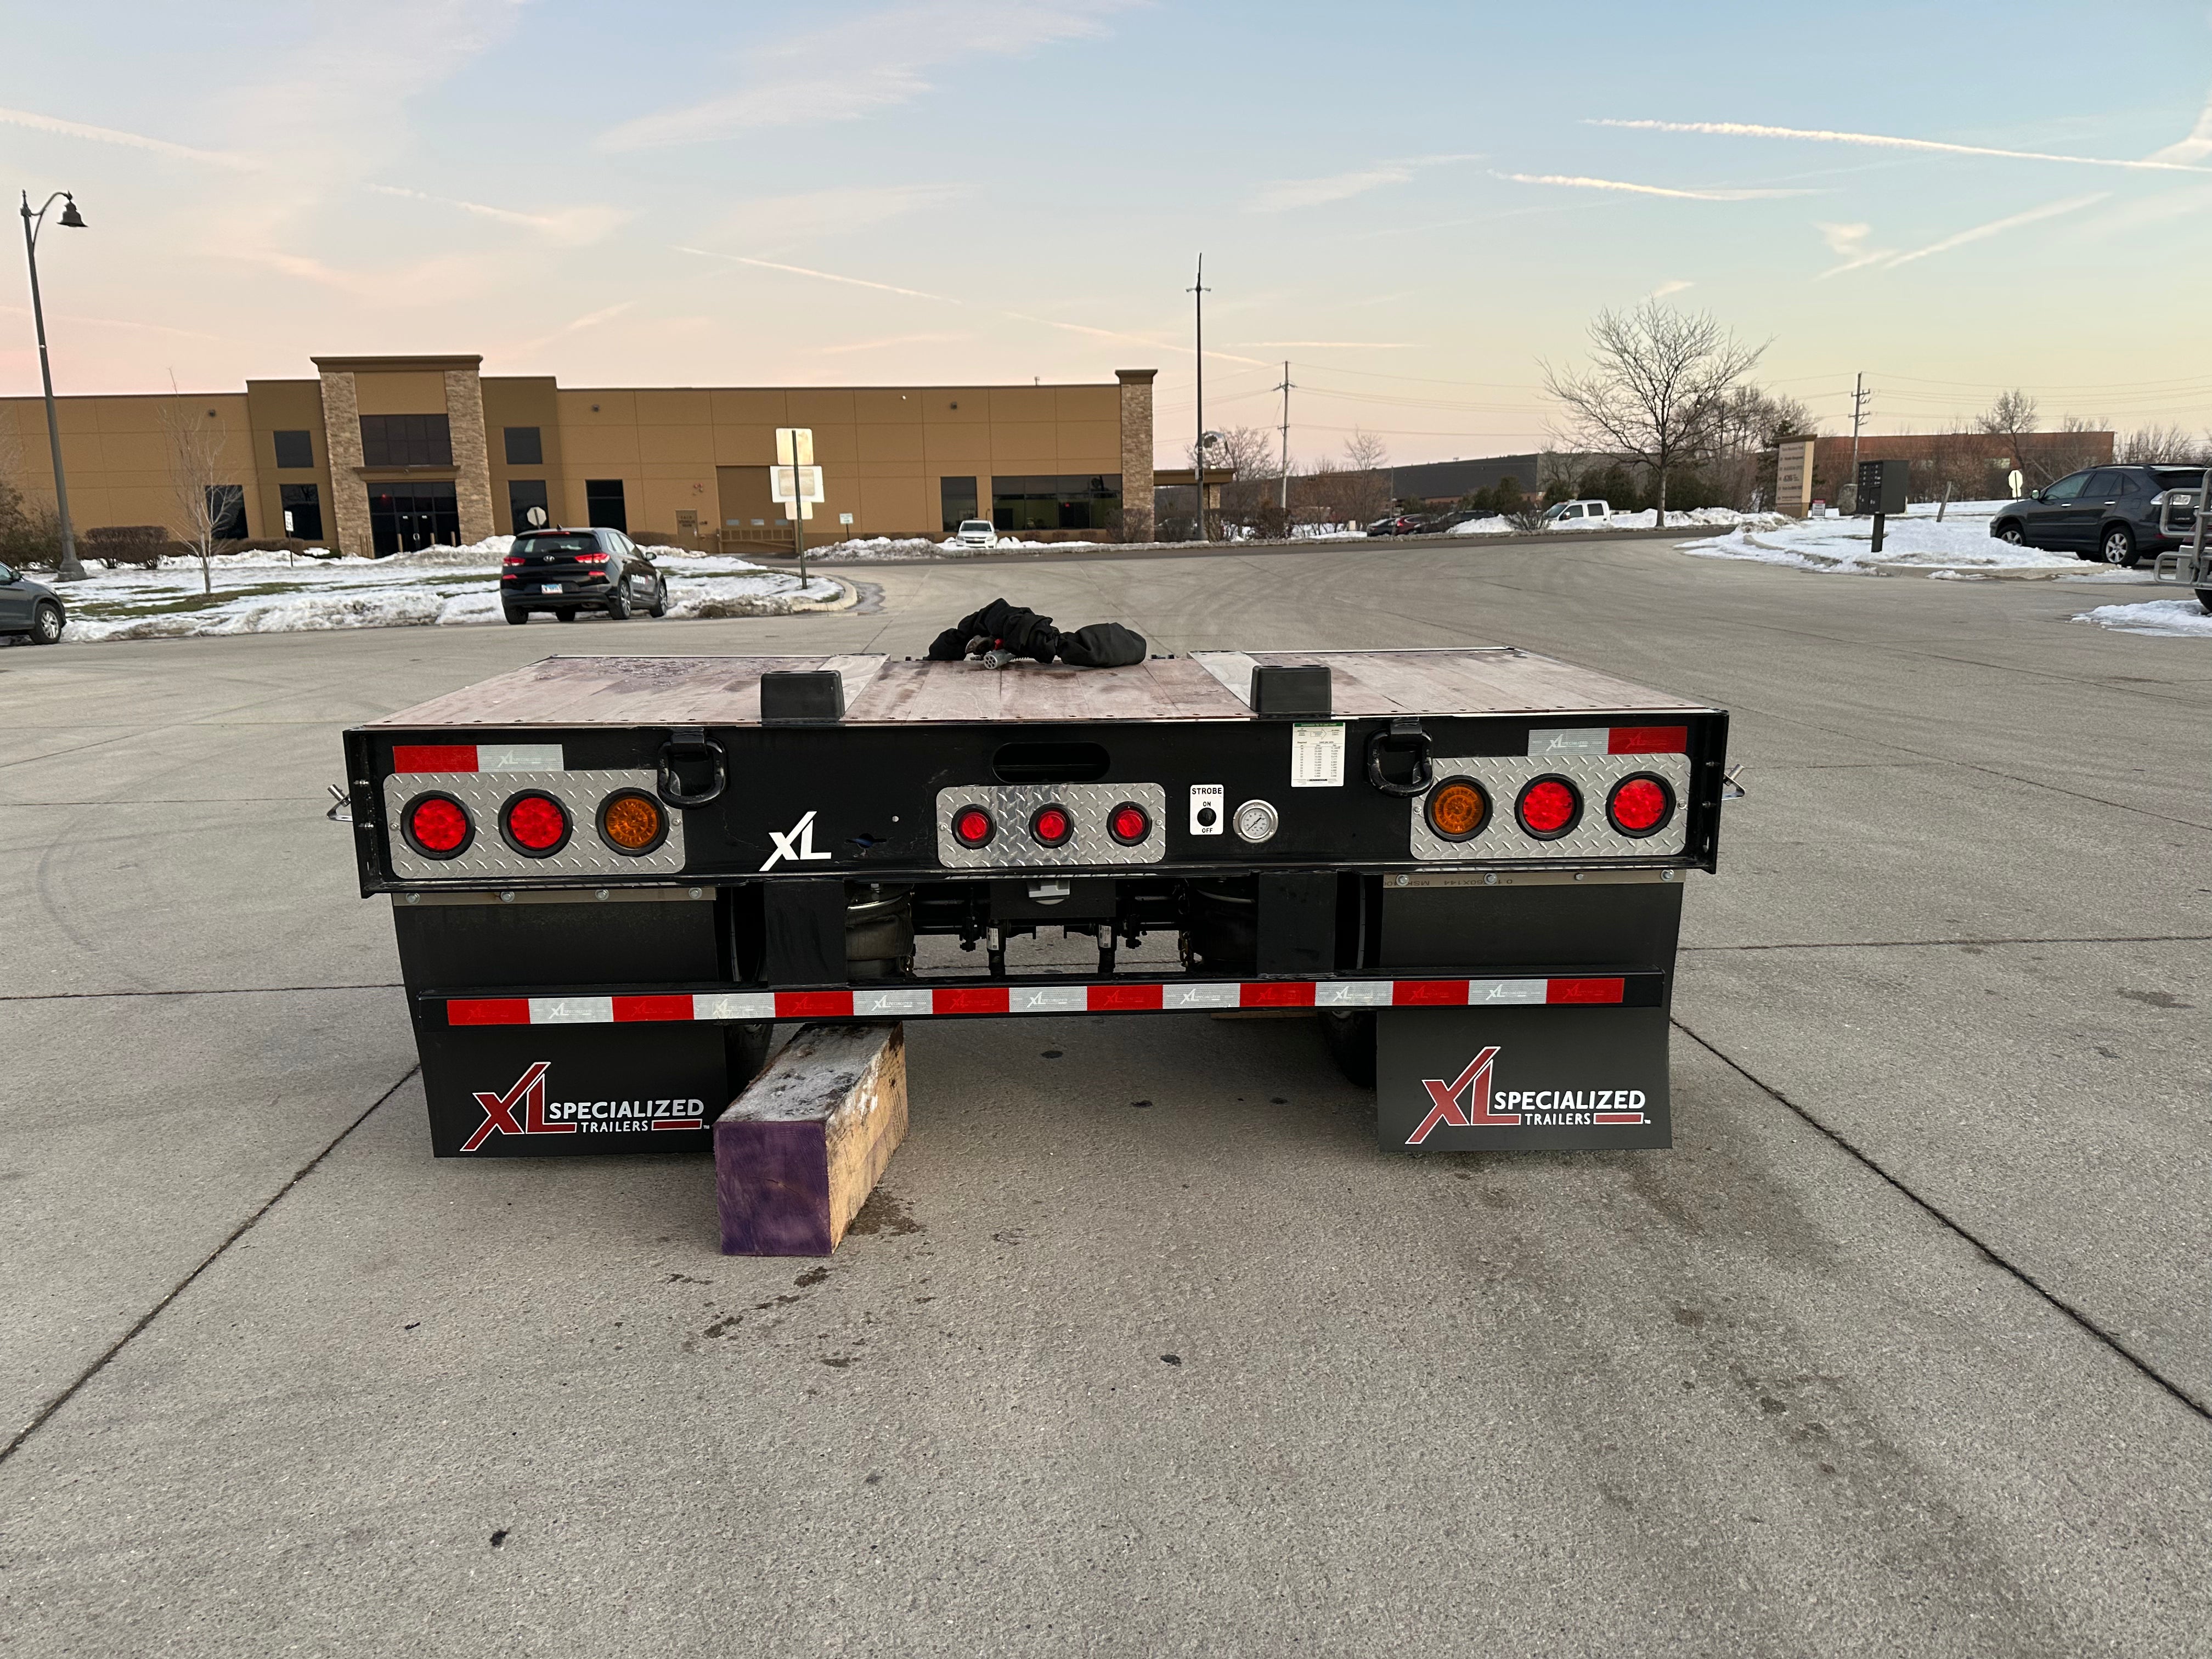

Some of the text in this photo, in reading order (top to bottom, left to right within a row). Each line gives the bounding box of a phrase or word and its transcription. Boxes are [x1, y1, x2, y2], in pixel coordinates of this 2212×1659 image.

[759, 811, 832, 871] XL
[460, 1061, 704, 1152] XL SPECIALIZED
[1405, 1046, 1645, 1144] XL SPECIALIZED
[1525, 1113, 1590, 1125] TRAILERS
[581, 1120, 648, 1133] TRAILERS
